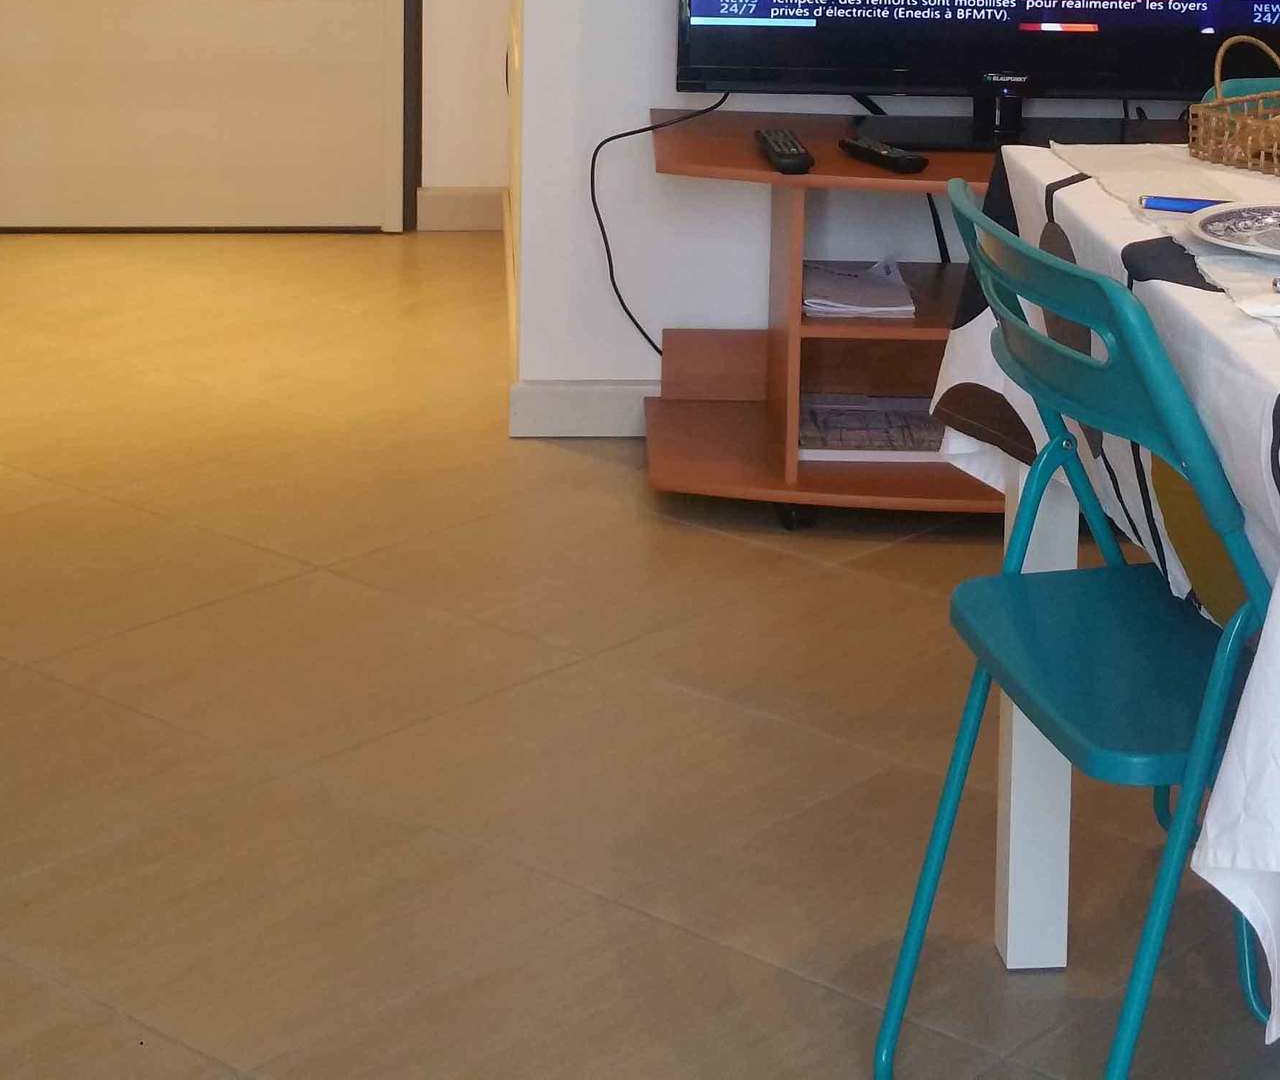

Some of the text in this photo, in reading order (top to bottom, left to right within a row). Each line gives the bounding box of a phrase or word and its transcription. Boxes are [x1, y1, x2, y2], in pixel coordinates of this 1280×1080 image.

[720, 3, 756, 15] 24/7
[770, 5, 1011, 21] privés d'électricité (Enedis à BFMTV).
[1146, 0, 1164, 10] les
[1168, 0, 1208, 13] foyers
